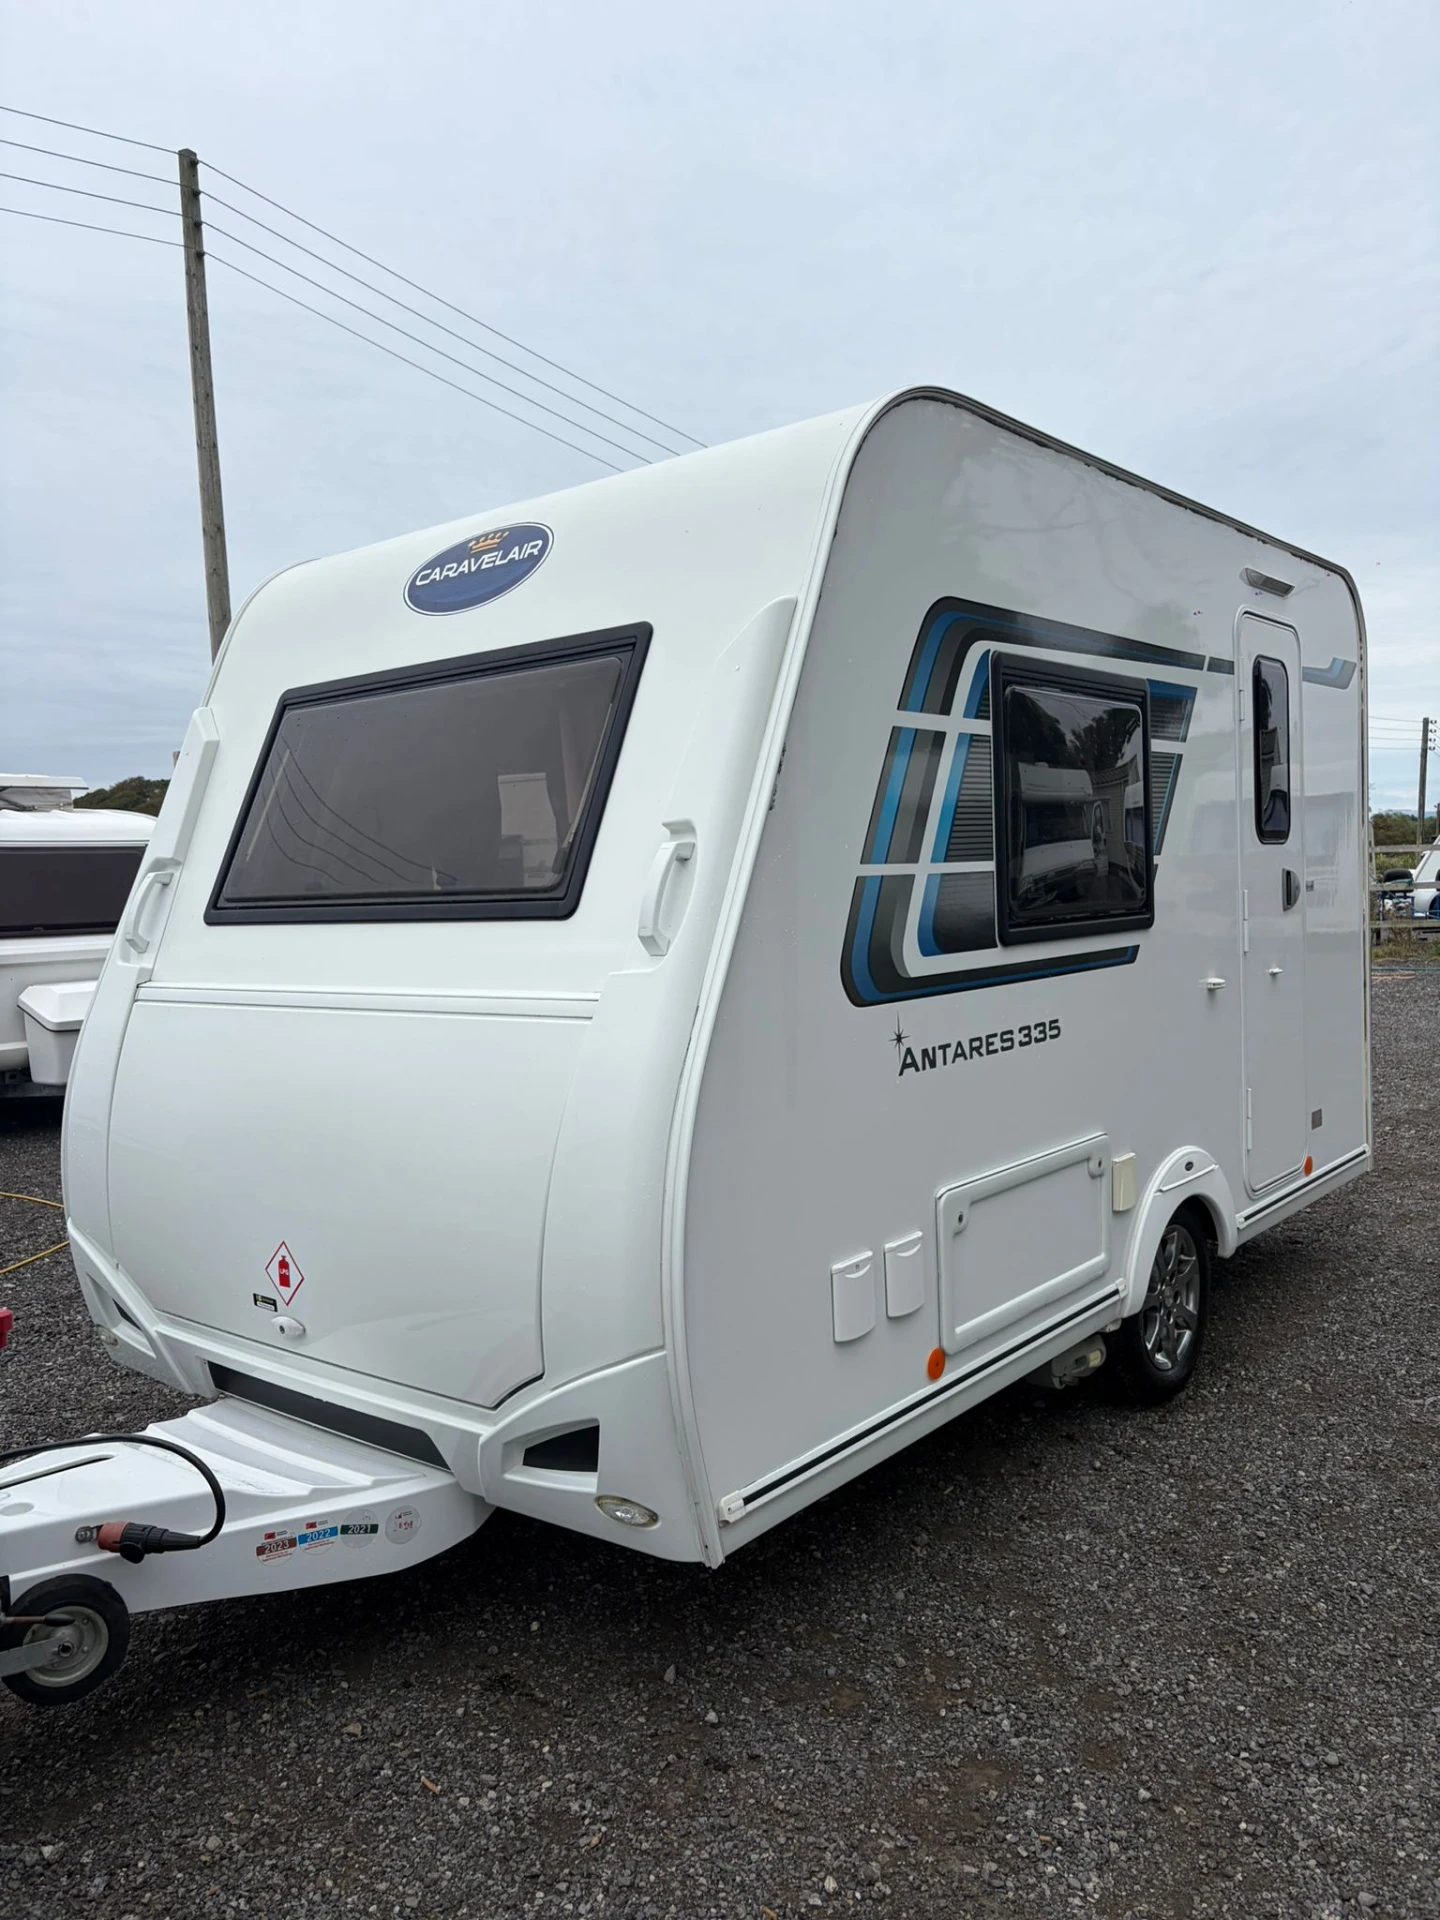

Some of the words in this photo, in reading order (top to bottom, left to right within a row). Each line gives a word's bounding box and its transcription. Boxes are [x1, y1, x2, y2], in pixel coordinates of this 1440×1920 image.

[415, 539, 543, 586] CARAVELAIR
[898, 1029, 1015, 1077] ANTARES
[1018, 1018, 1061, 1048] 335
[306, 1529, 331, 1542] 2022
[347, 1524, 371, 1534] 2021
[264, 1540, 290, 1554] 2023
